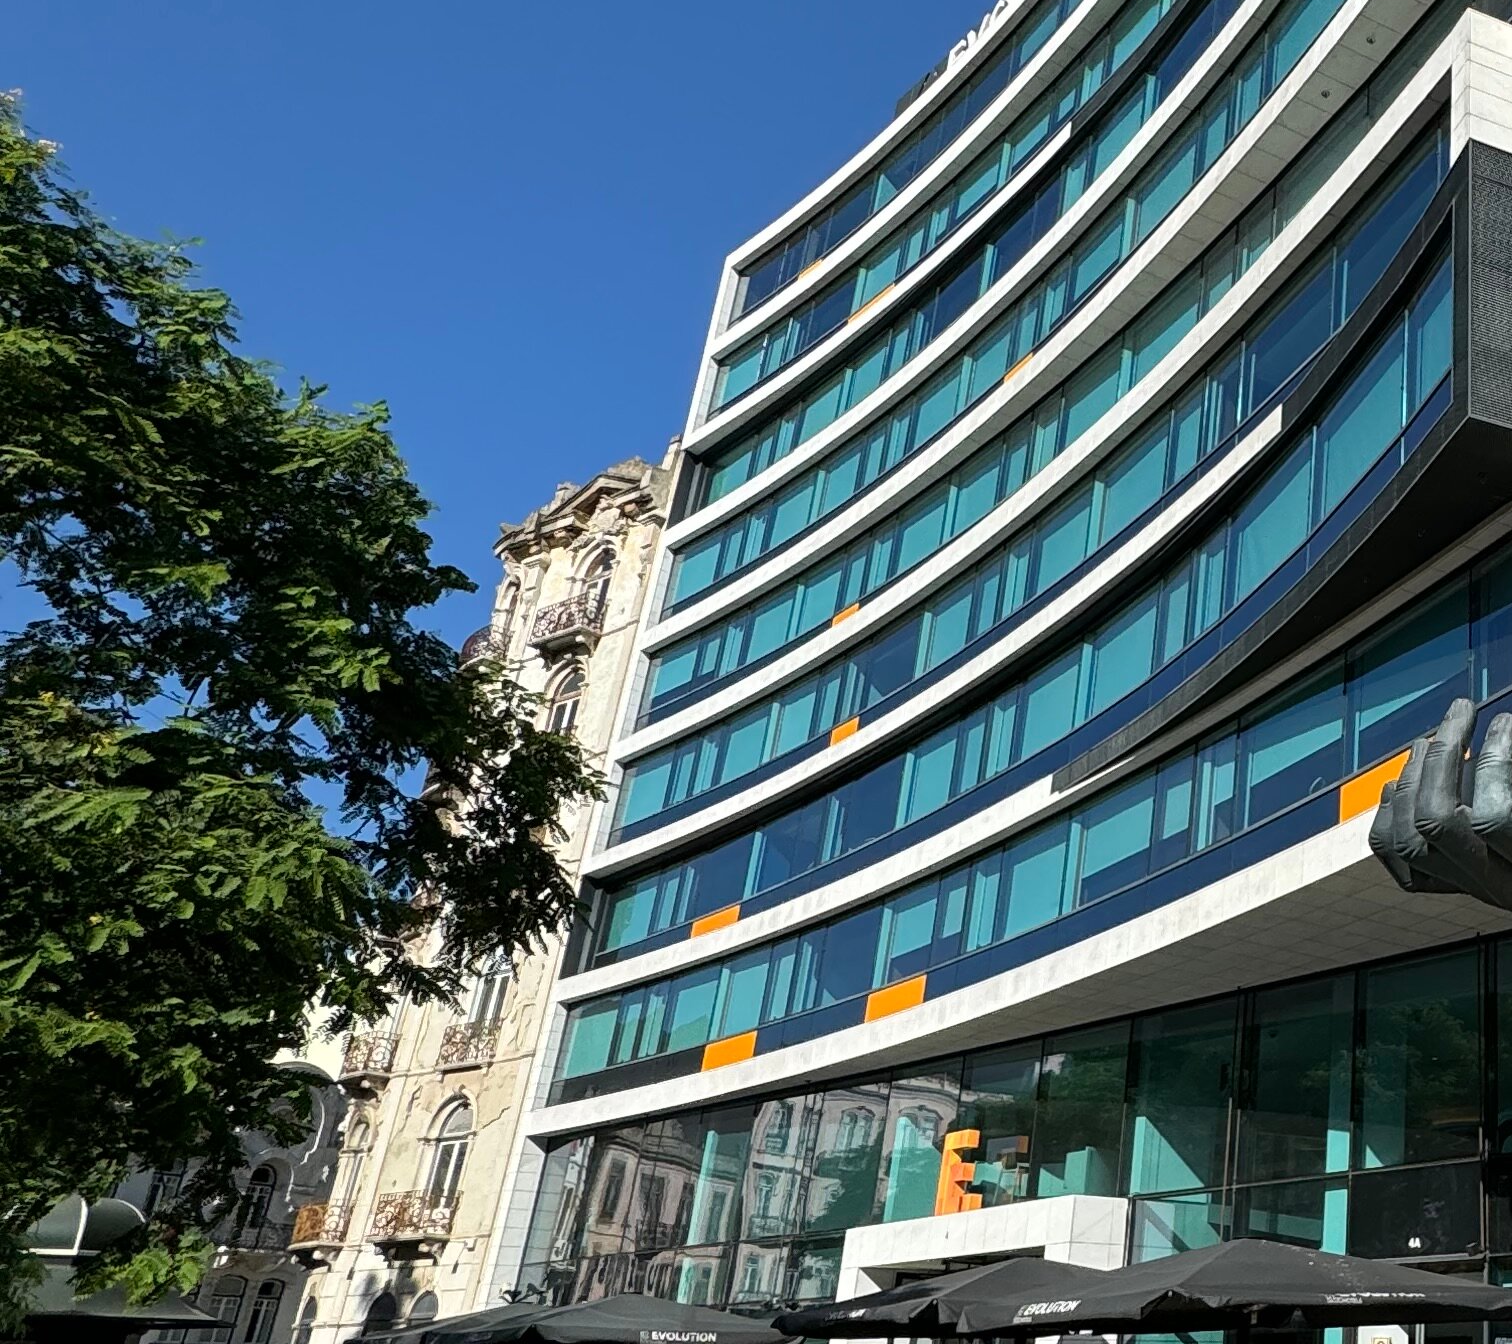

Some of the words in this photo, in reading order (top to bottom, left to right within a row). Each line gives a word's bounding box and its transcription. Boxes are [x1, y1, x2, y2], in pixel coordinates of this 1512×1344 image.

[935, 1128, 983, 1217] E
[1408, 1237, 1422, 1249] 4A
[1023, 1300, 1082, 1316] EVOLUTION
[651, 1331, 717, 1343] EVOLUTION
